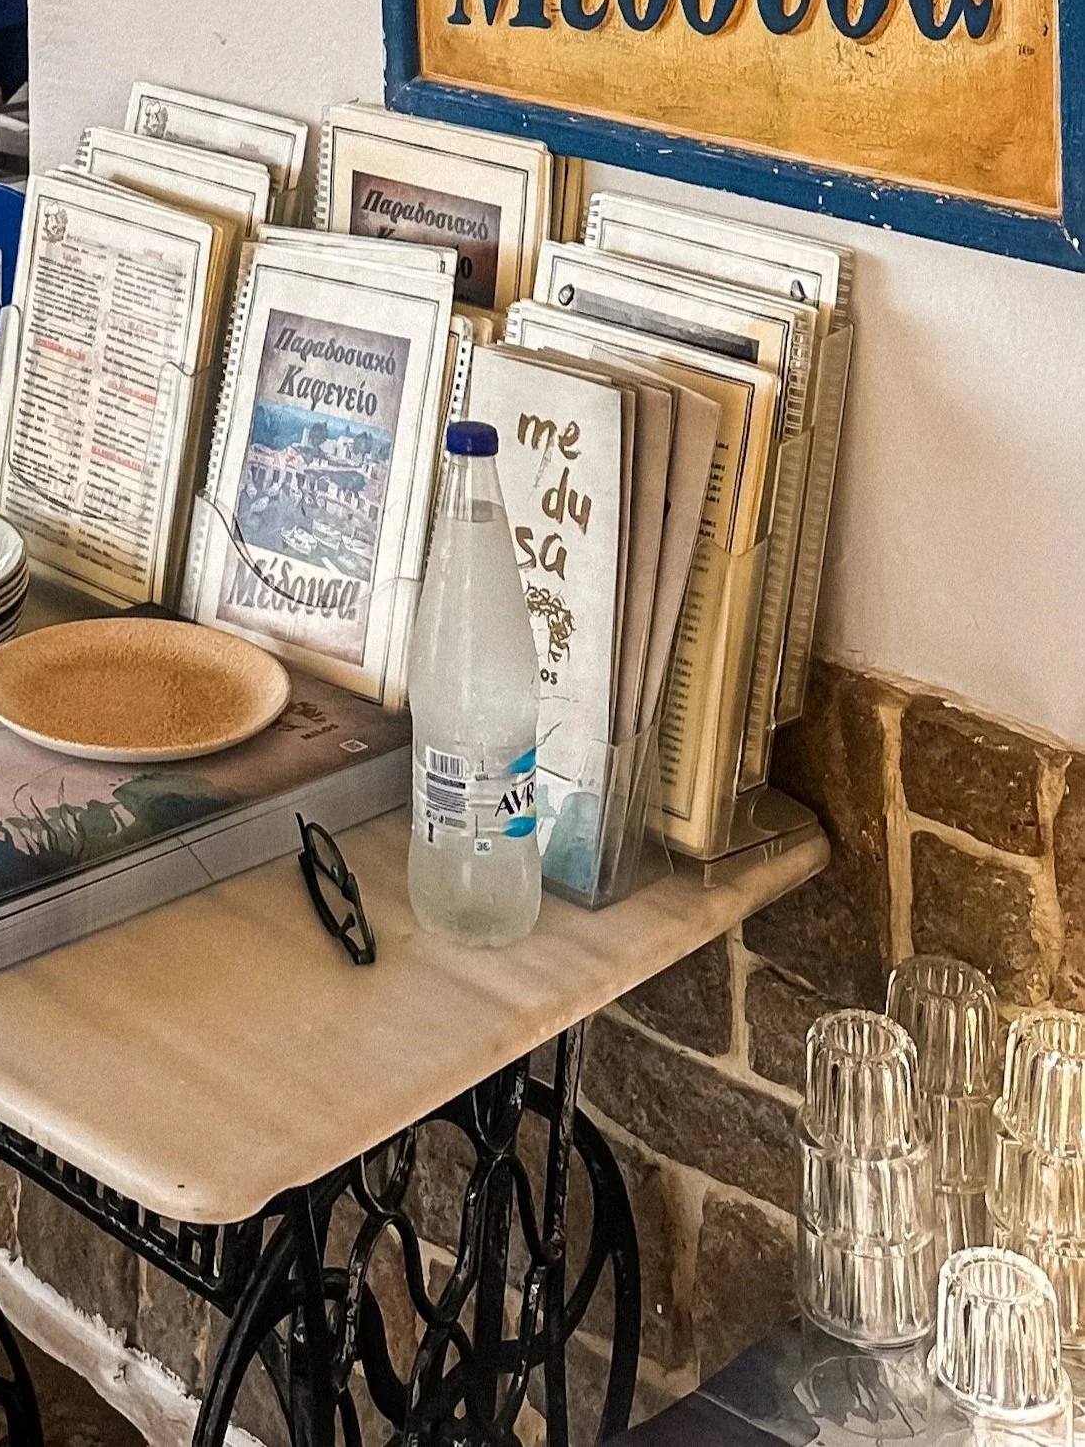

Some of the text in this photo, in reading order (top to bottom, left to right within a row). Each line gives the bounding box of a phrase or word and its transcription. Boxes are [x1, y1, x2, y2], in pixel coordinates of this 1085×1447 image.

[361, 188, 489, 241] Παραδοσιακό
[273, 327, 396, 375] Παραδοσιακό
[277, 363, 378, 416] Καφενείο
[542, 466, 592, 536] du
[226, 556, 361, 621] Μέδουσα
